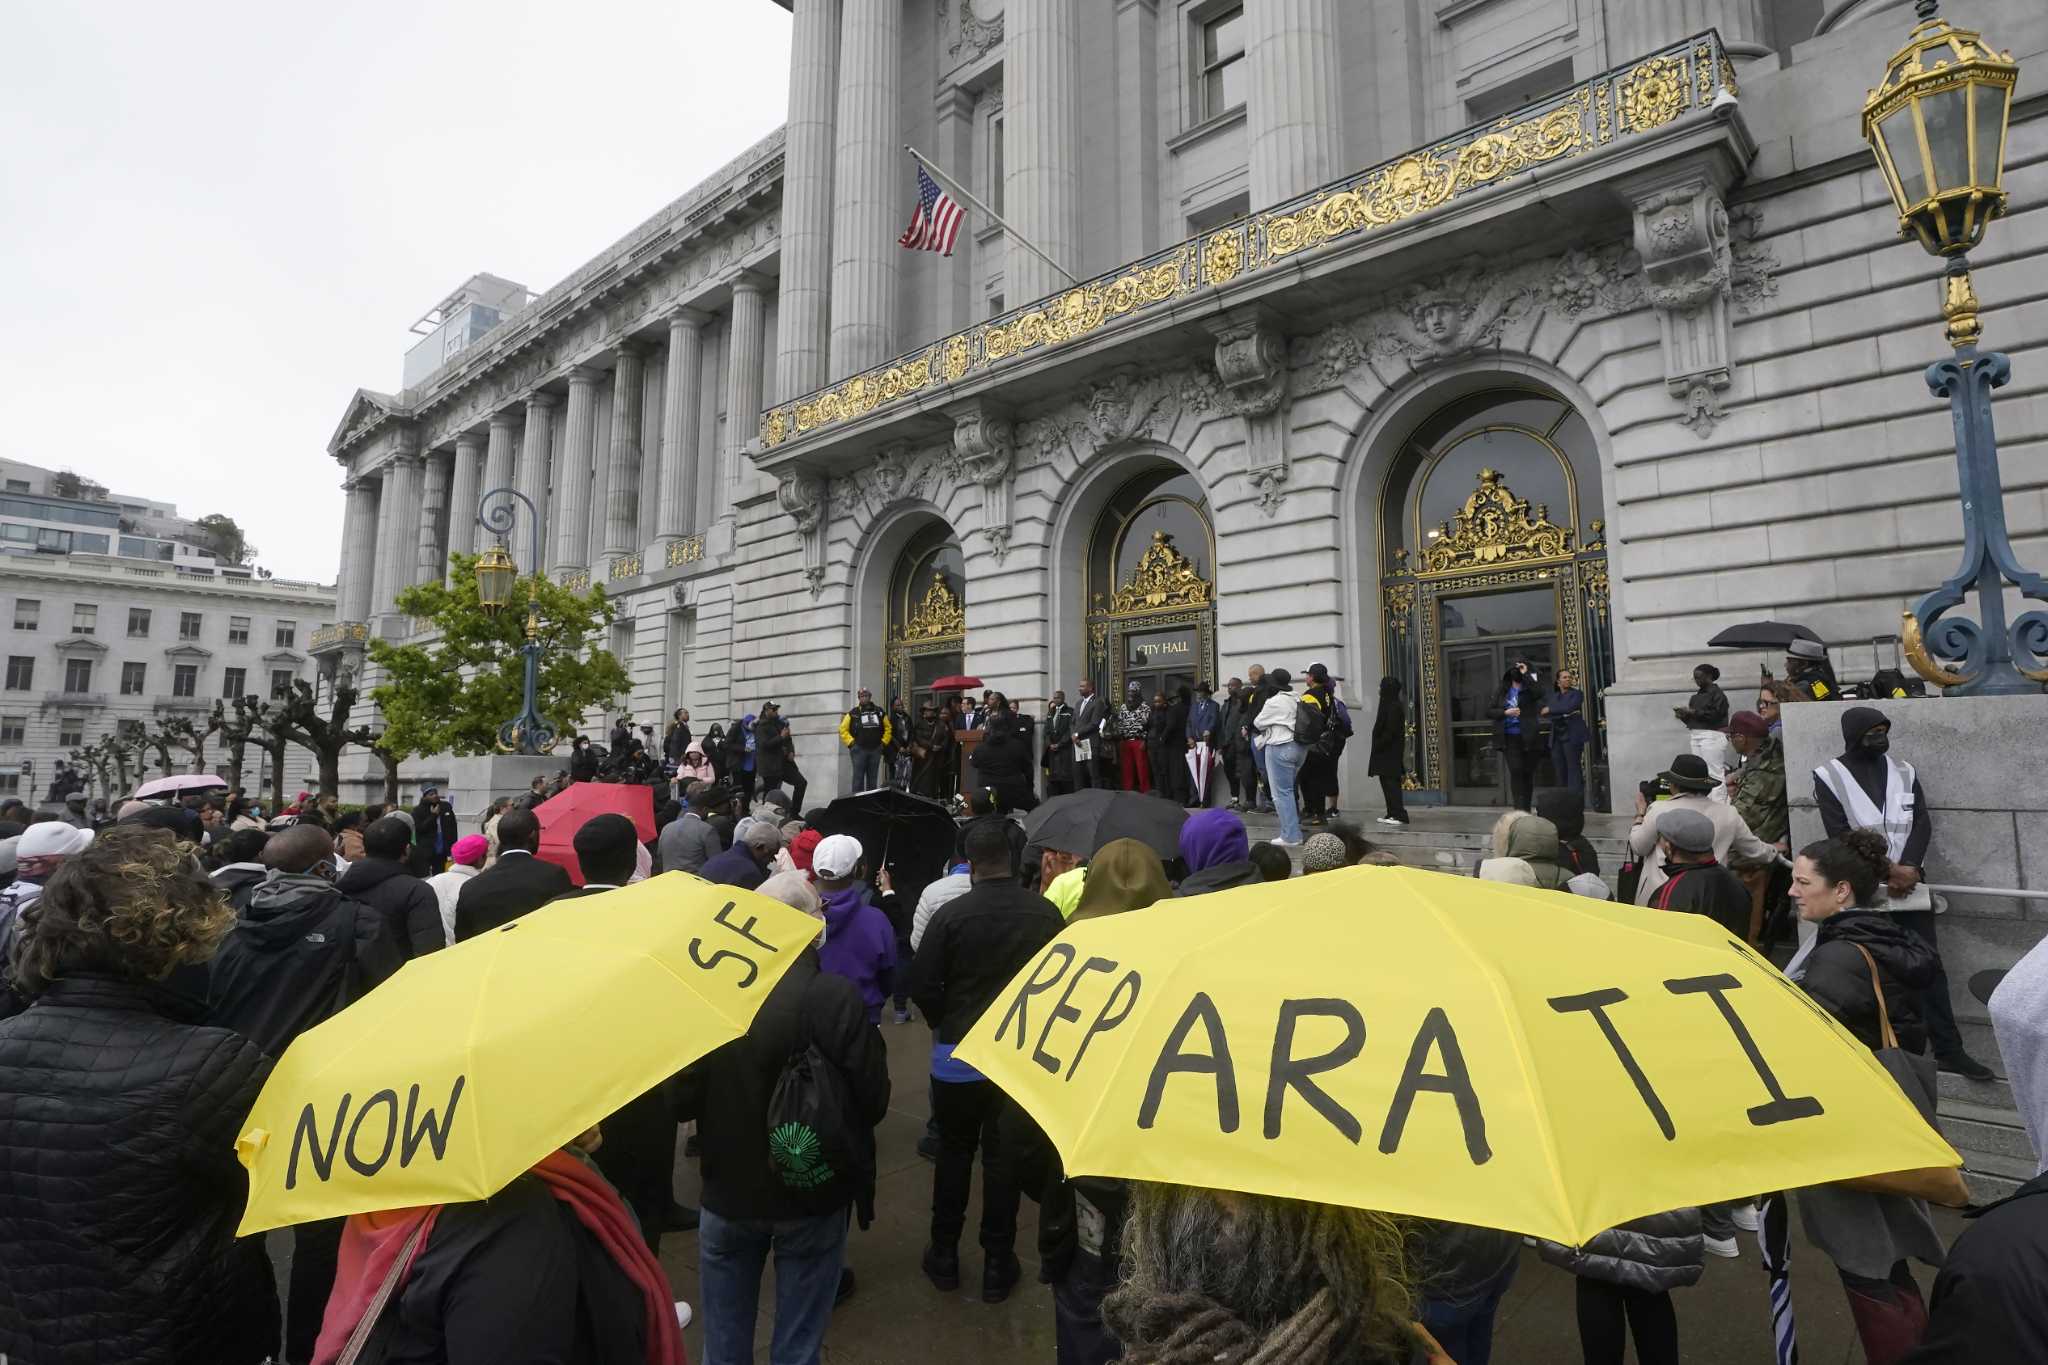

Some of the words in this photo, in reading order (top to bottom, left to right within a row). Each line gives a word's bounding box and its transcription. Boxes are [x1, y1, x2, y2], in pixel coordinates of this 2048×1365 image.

[1163, 641, 1189, 654] HALL
[688, 901, 780, 989] SF
[285, 1075, 465, 1190] NOW
